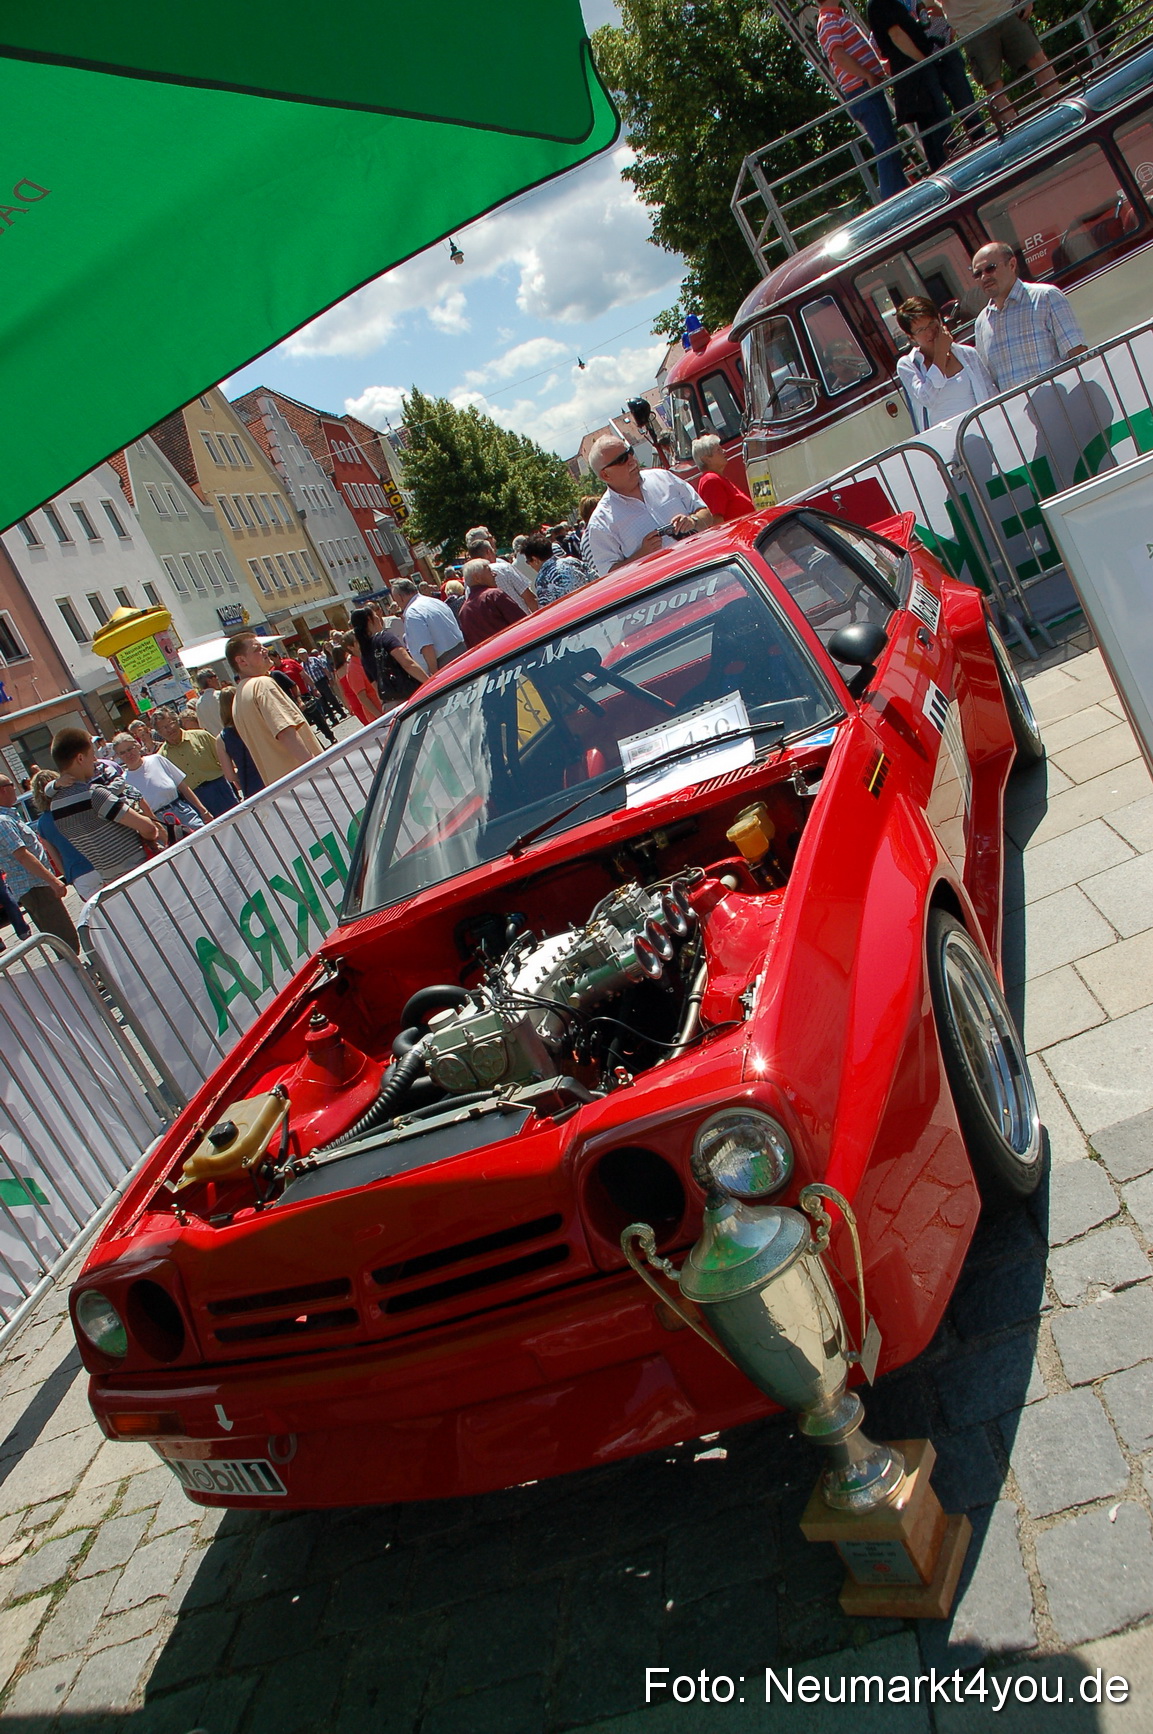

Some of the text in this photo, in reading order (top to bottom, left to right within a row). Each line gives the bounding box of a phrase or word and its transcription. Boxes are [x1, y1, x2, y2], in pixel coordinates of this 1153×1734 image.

[411, 575, 719, 736] C. Böhm-Mrsport
[171, 1460, 253, 1493] Mobil
